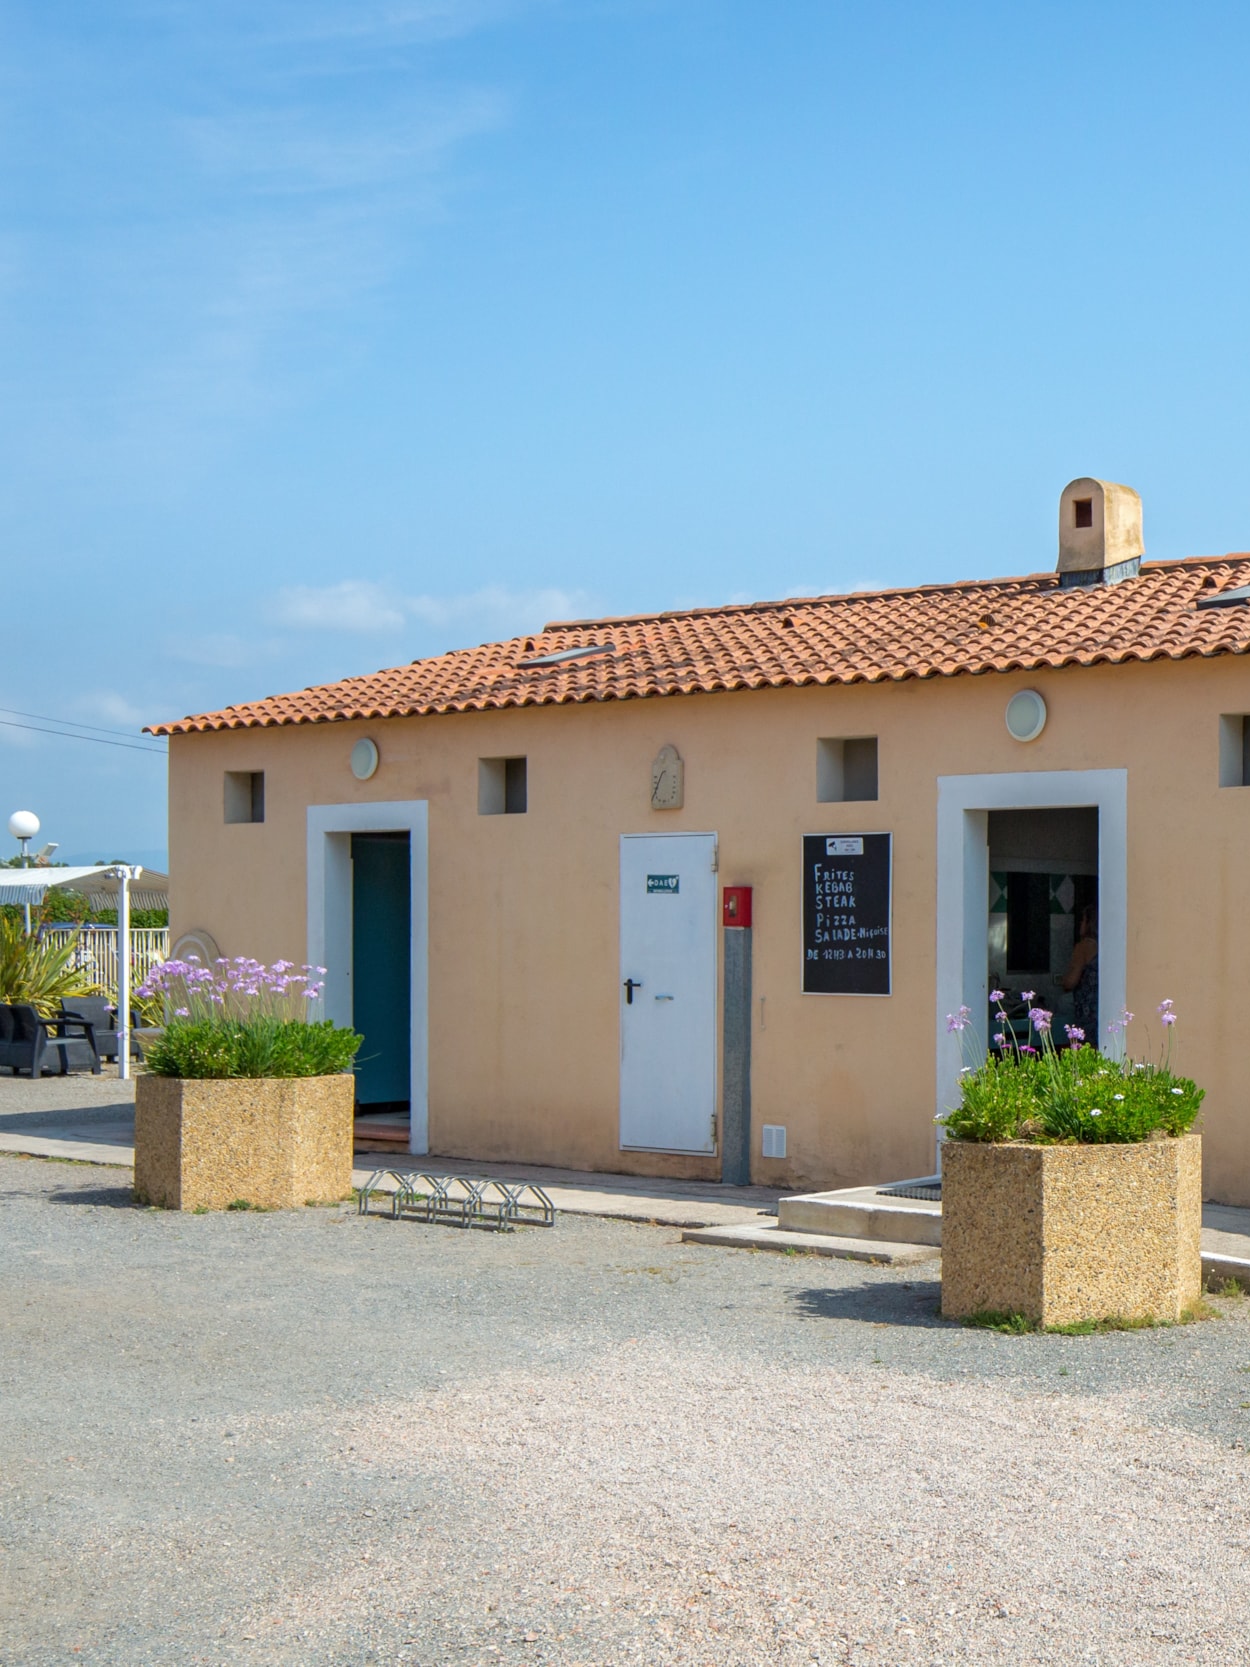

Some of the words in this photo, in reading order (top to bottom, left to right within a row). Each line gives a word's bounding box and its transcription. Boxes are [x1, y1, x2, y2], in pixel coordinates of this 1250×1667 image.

[654, 879, 668, 887] DAE
[815, 881, 853, 895] KEBAB
[815, 895, 856, 910] STEAK
[806, 949, 819, 960] DE
[847, 949, 853, 959] A
